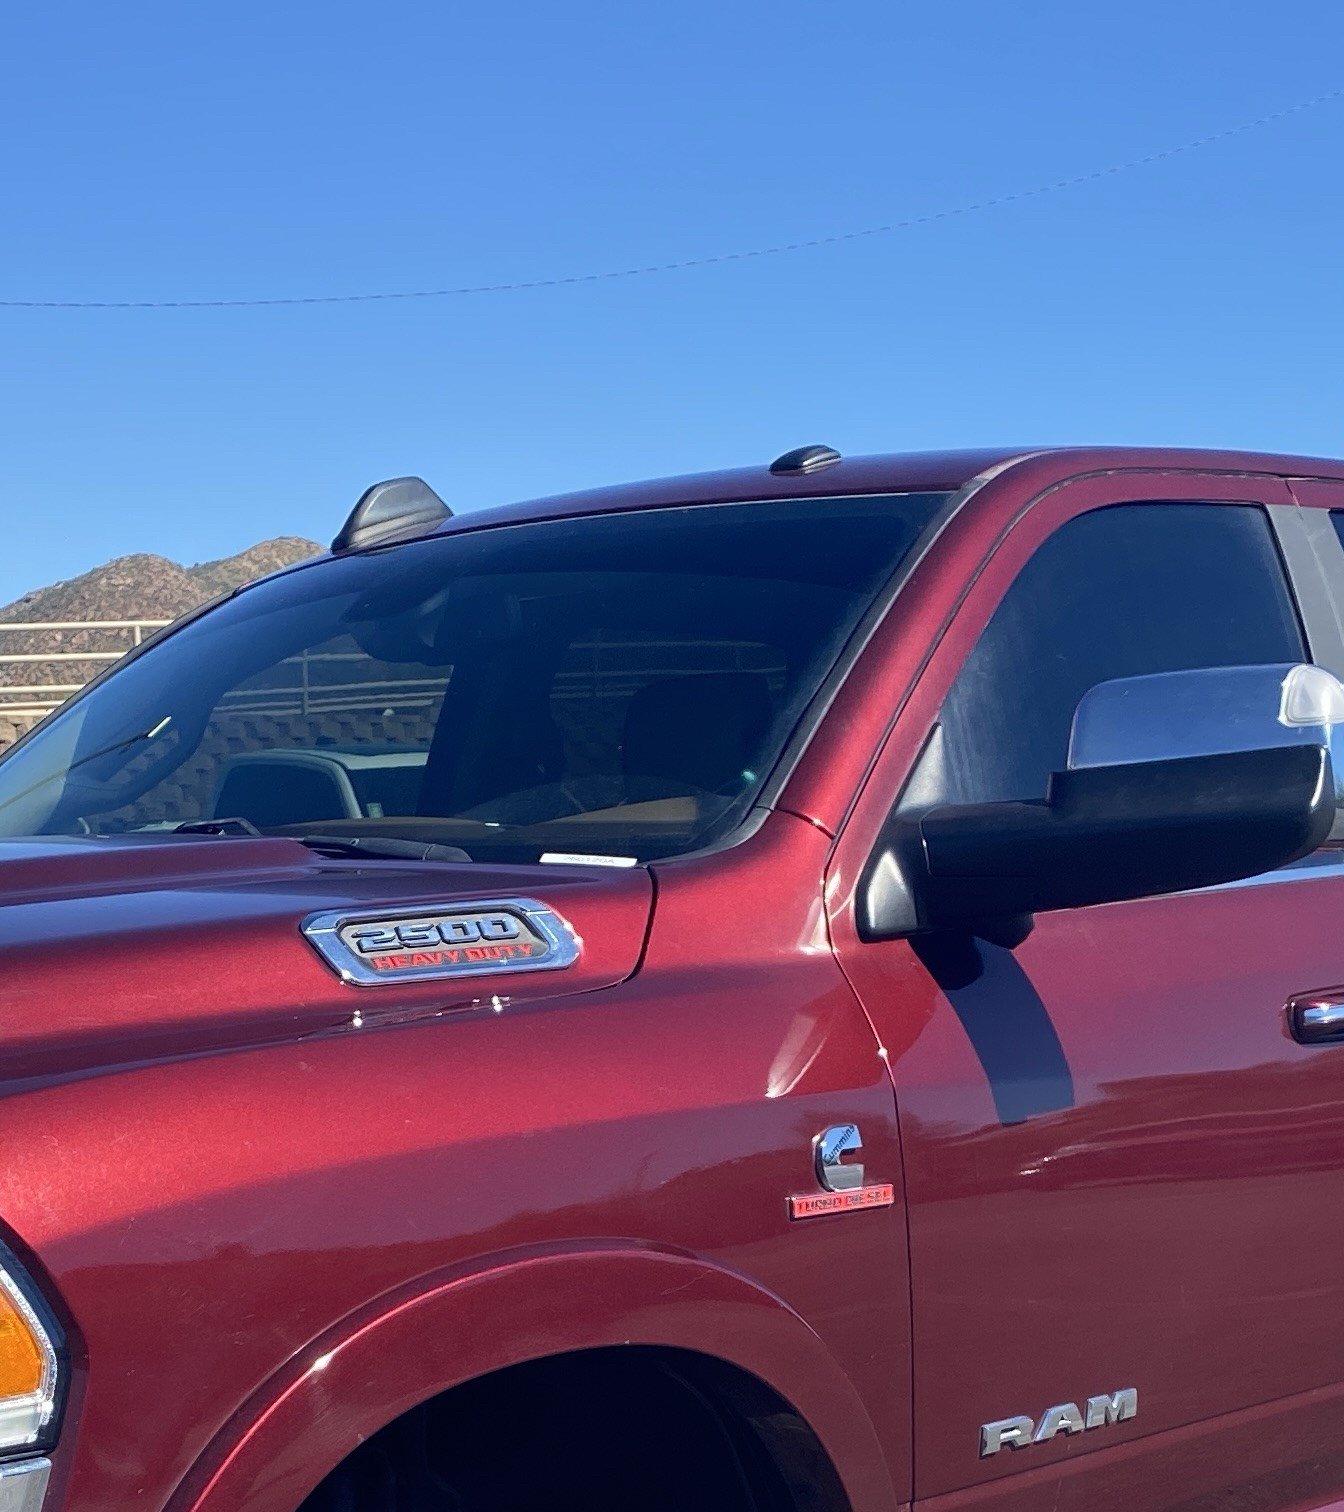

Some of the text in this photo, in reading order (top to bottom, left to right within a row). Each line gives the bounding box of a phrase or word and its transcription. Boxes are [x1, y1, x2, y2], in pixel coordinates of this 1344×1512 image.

[351, 915, 521, 953] 2500
[372, 943, 534, 971] HEAVY DUTY
[824, 1125, 856, 1164] Cummins
[979, 1387, 1138, 1460] RAM
